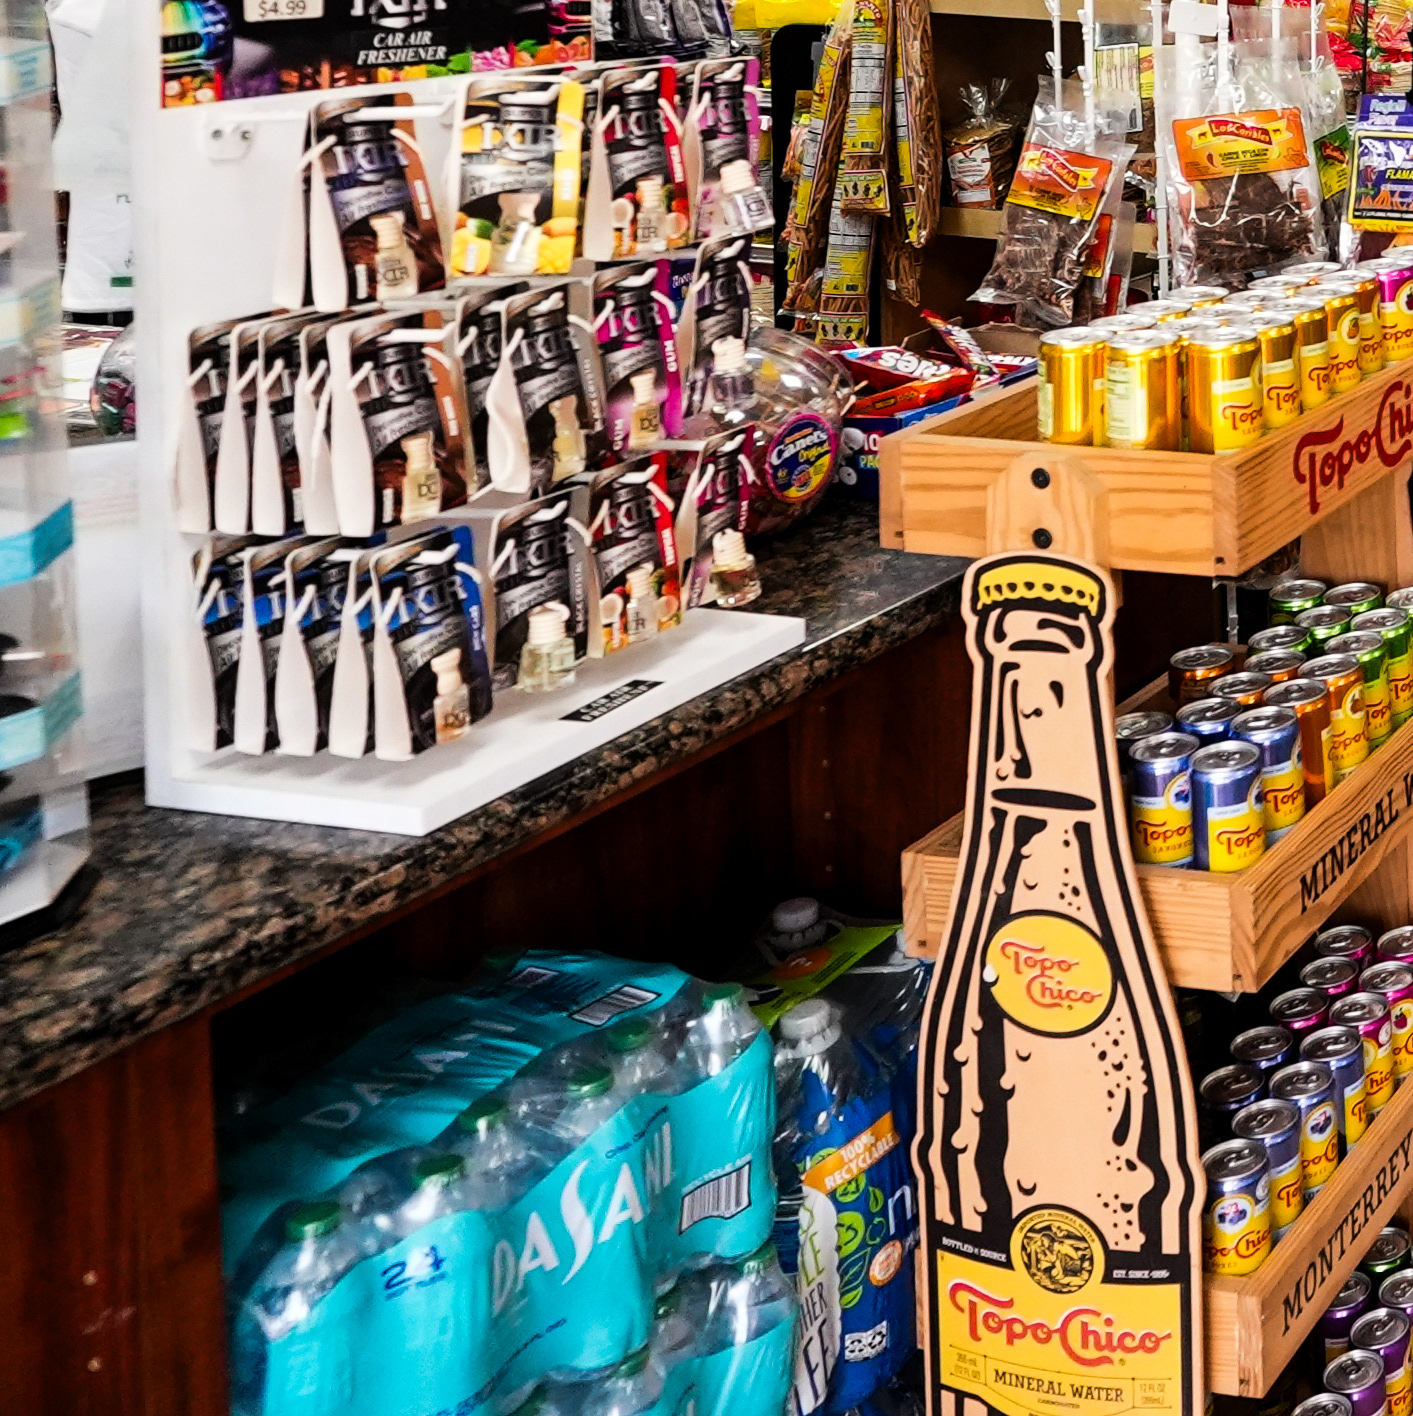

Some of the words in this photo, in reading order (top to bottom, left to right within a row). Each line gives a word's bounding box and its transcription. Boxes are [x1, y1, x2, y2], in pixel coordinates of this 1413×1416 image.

[257, 0, 307, 20] $4.99
[356, 45, 448, 66] FRESHENER
[373, 31, 405, 49] CAR
[407, 30, 433, 46] AIR
[1292, 412, 1377, 516] Topo
[1300, 790, 1400, 915] MINERAL
[999, 939, 1080, 976] Topo
[1025, 975, 1104, 1010] Chico
[948, 1278, 1056, 1347] Topo
[1057, 1306, 1173, 1368] Chico
[993, 1369, 1067, 1398] MINERAL
[1070, 1379, 1125, 1404] WATER
